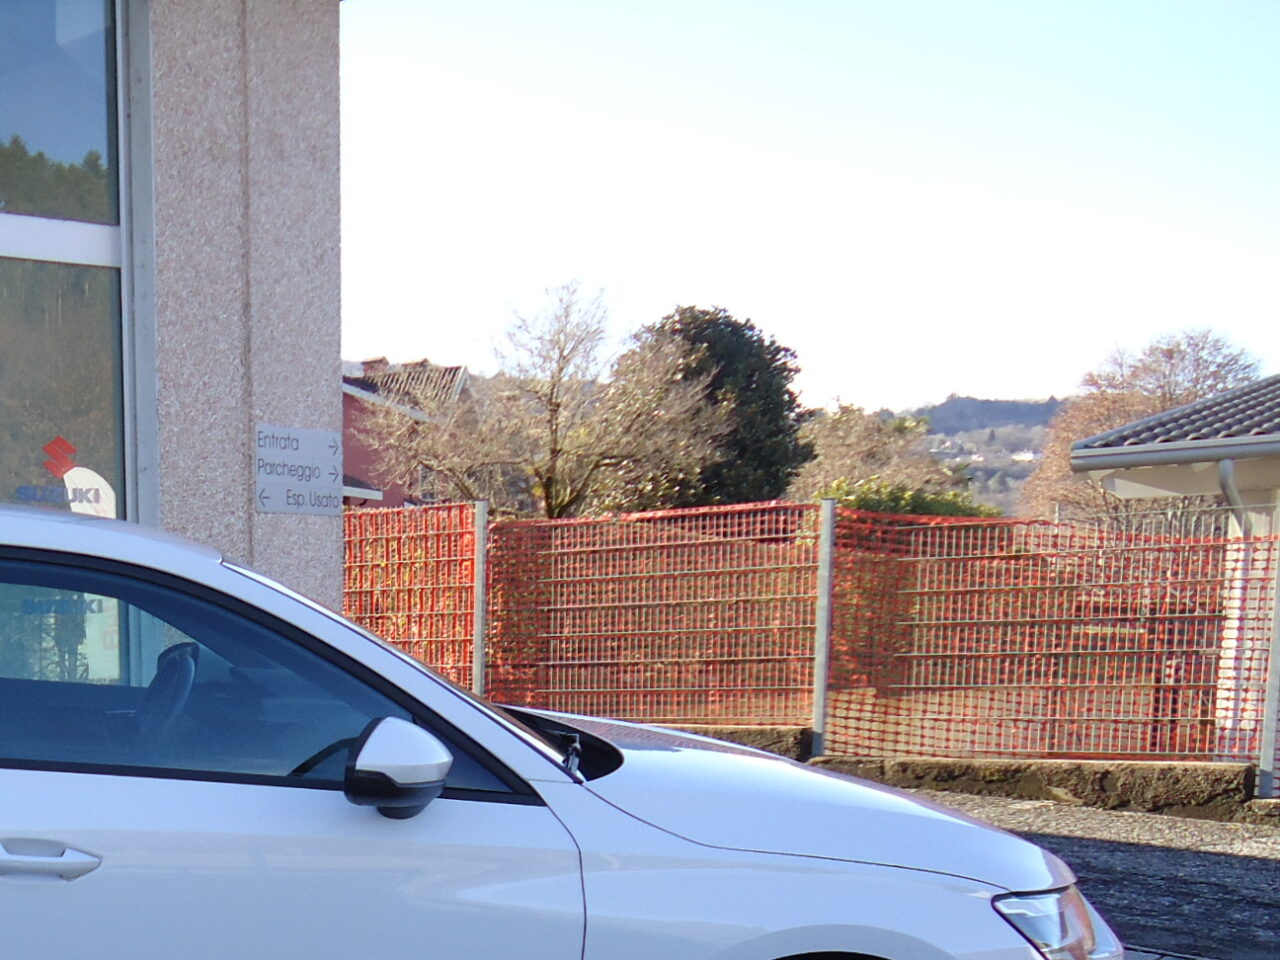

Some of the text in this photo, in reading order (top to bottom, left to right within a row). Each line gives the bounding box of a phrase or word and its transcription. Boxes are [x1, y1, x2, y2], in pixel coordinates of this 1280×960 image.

[257, 431, 299, 451] Entrata
[257, 458, 321, 482] Parcheggio
[16, 485, 101, 504] SUZUKI
[309, 491, 340, 508] Usato
